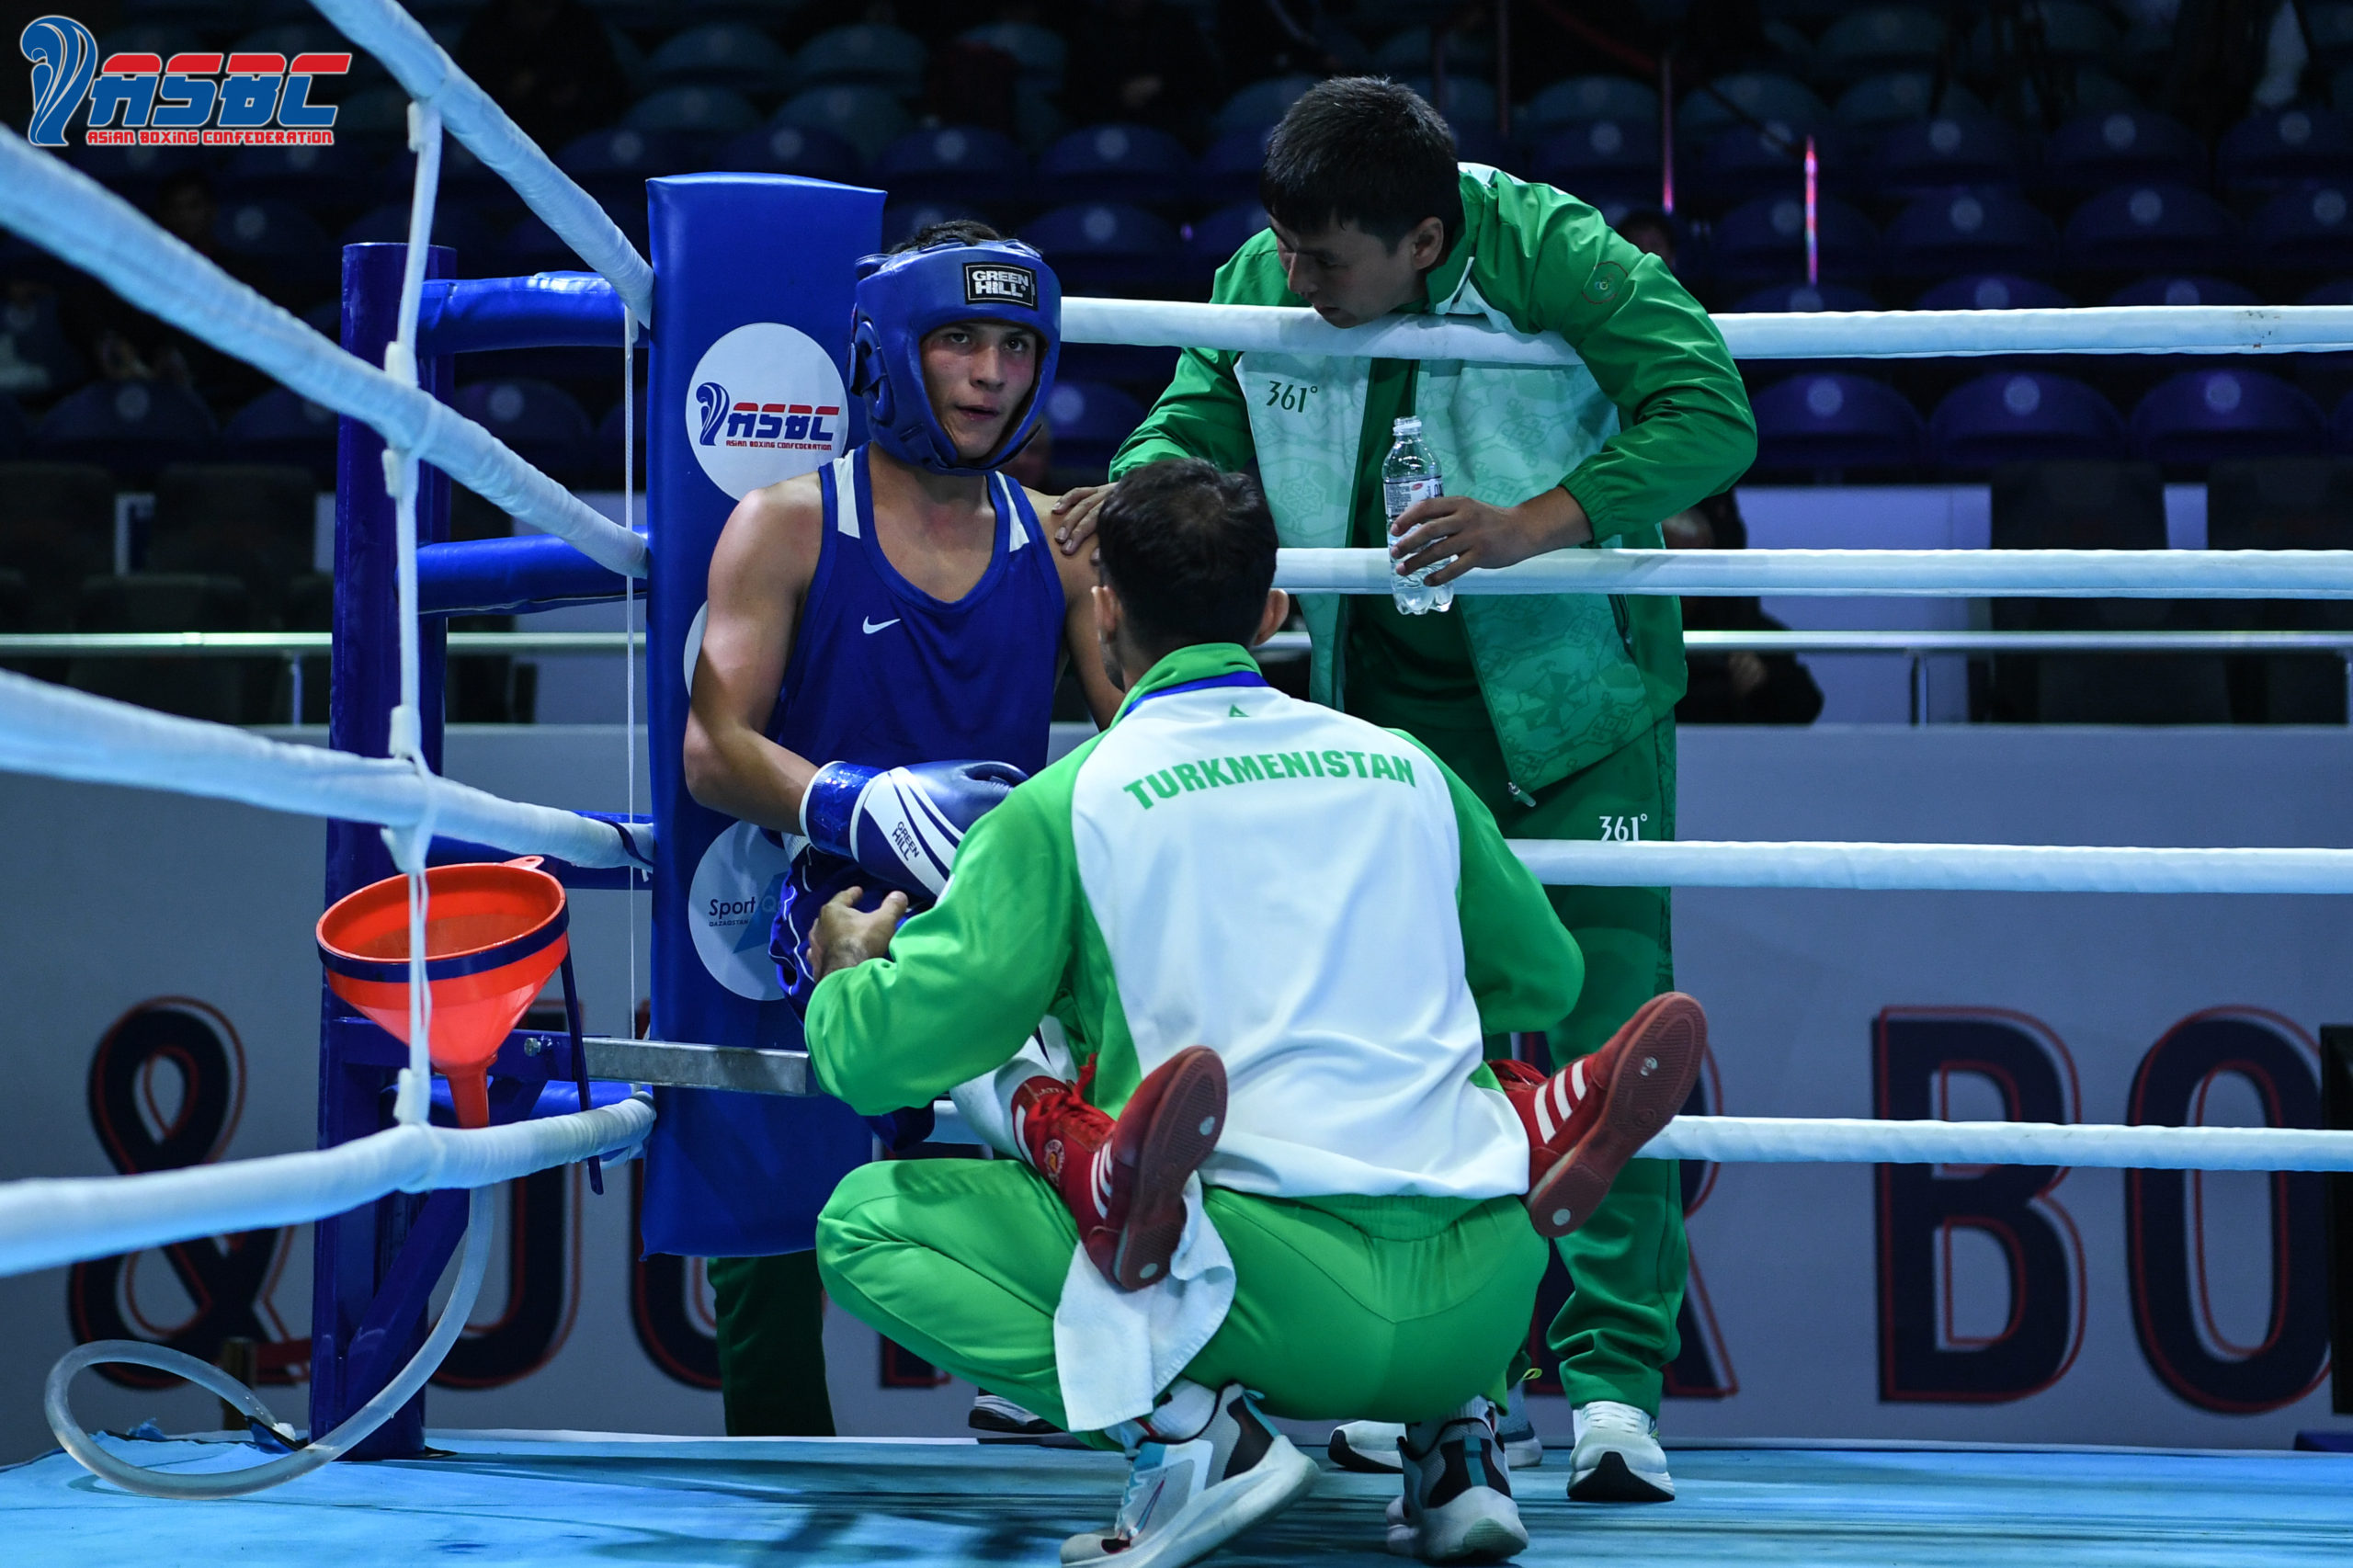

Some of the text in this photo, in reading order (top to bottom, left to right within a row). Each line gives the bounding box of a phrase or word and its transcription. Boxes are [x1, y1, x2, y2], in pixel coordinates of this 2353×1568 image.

[972, 270, 1029, 287] GREEN
[974, 281, 1024, 298] HILL
[726, 402, 840, 441] ASBC
[1122, 750, 1416, 810] TURKMENISTAN
[892, 827, 910, 861] HILL
[897, 821, 920, 858] GREEN
[709, 896, 756, 919] Sport
